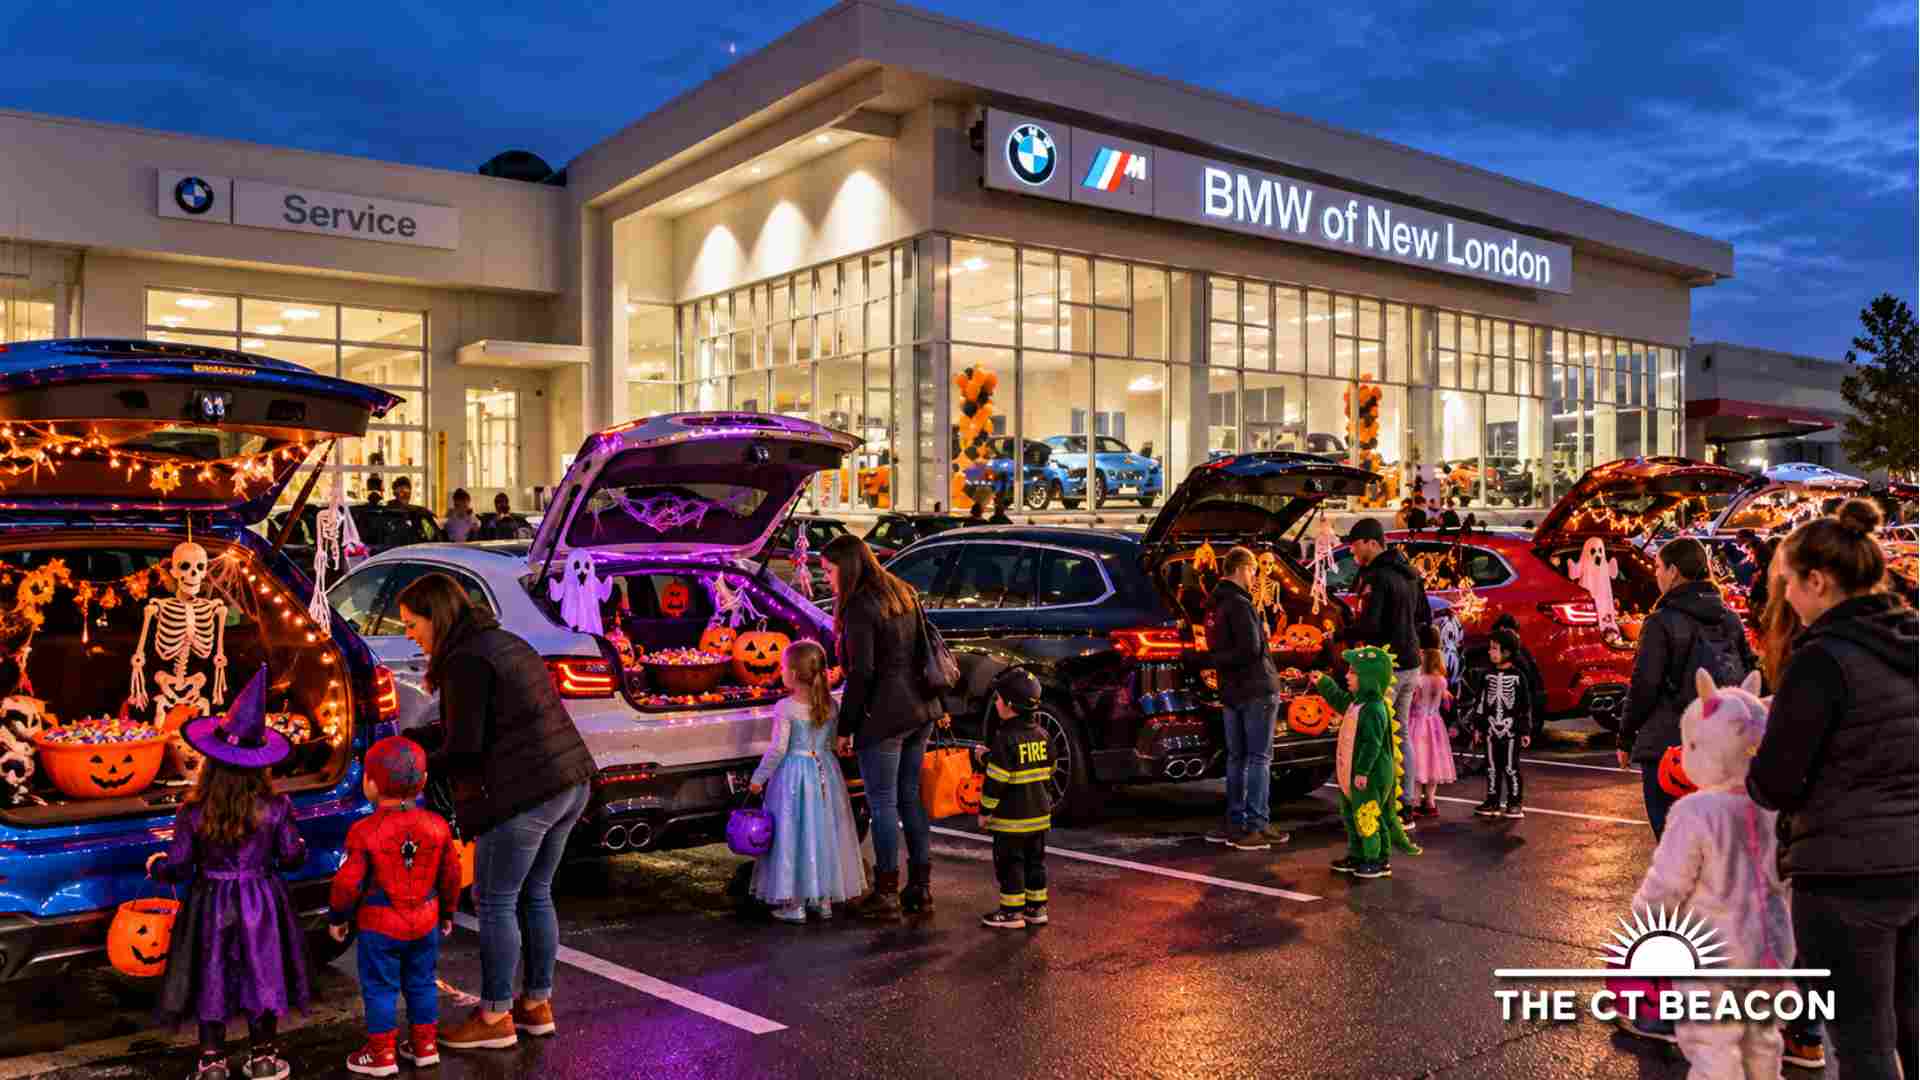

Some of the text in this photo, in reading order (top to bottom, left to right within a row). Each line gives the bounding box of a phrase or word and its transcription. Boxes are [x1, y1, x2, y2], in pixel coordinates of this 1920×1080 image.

[283, 194, 417, 238] Service
[1204, 167, 1551, 284] BMW of New London
[1018, 740, 1048, 764] FIRE
